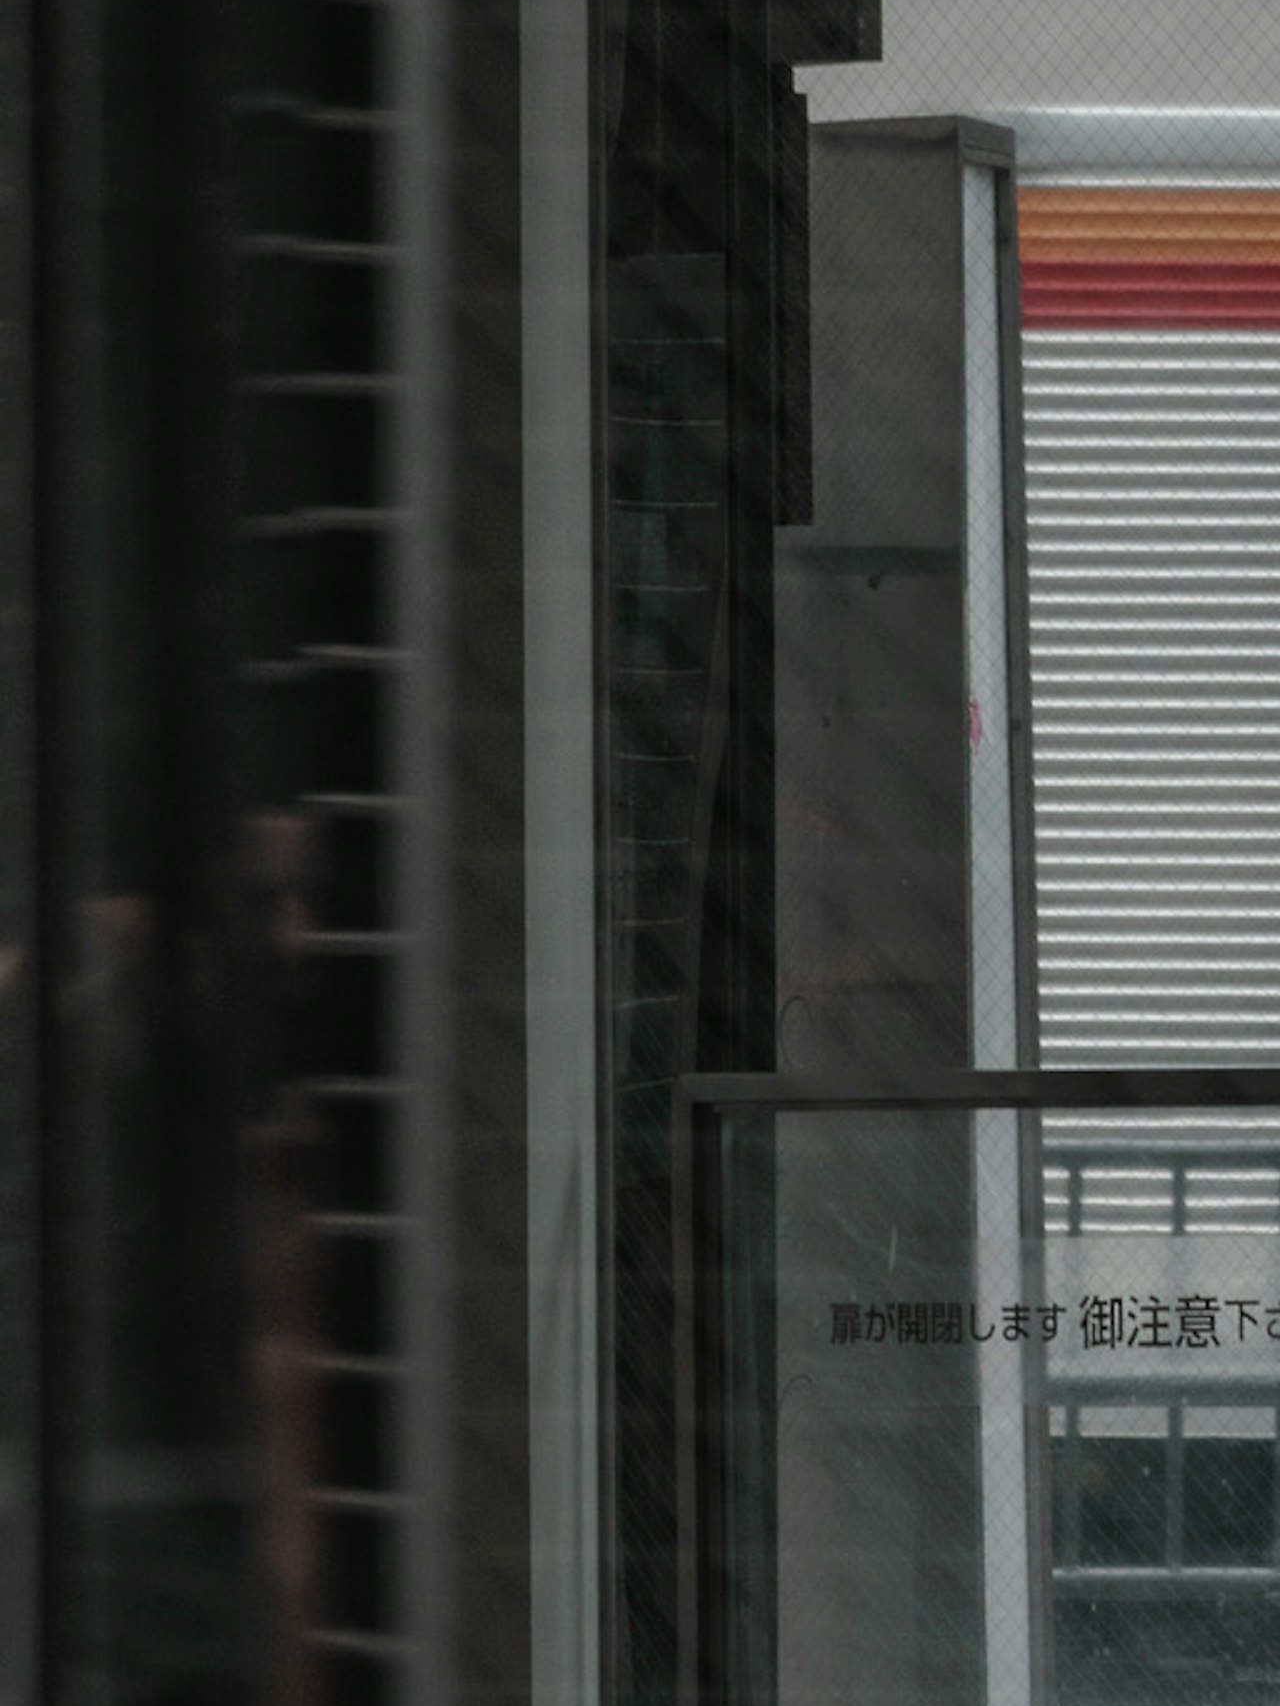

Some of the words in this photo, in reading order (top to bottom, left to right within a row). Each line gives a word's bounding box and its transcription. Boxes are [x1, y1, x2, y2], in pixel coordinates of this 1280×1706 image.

[829, 1302, 1066, 1344] 扉が開閉します
